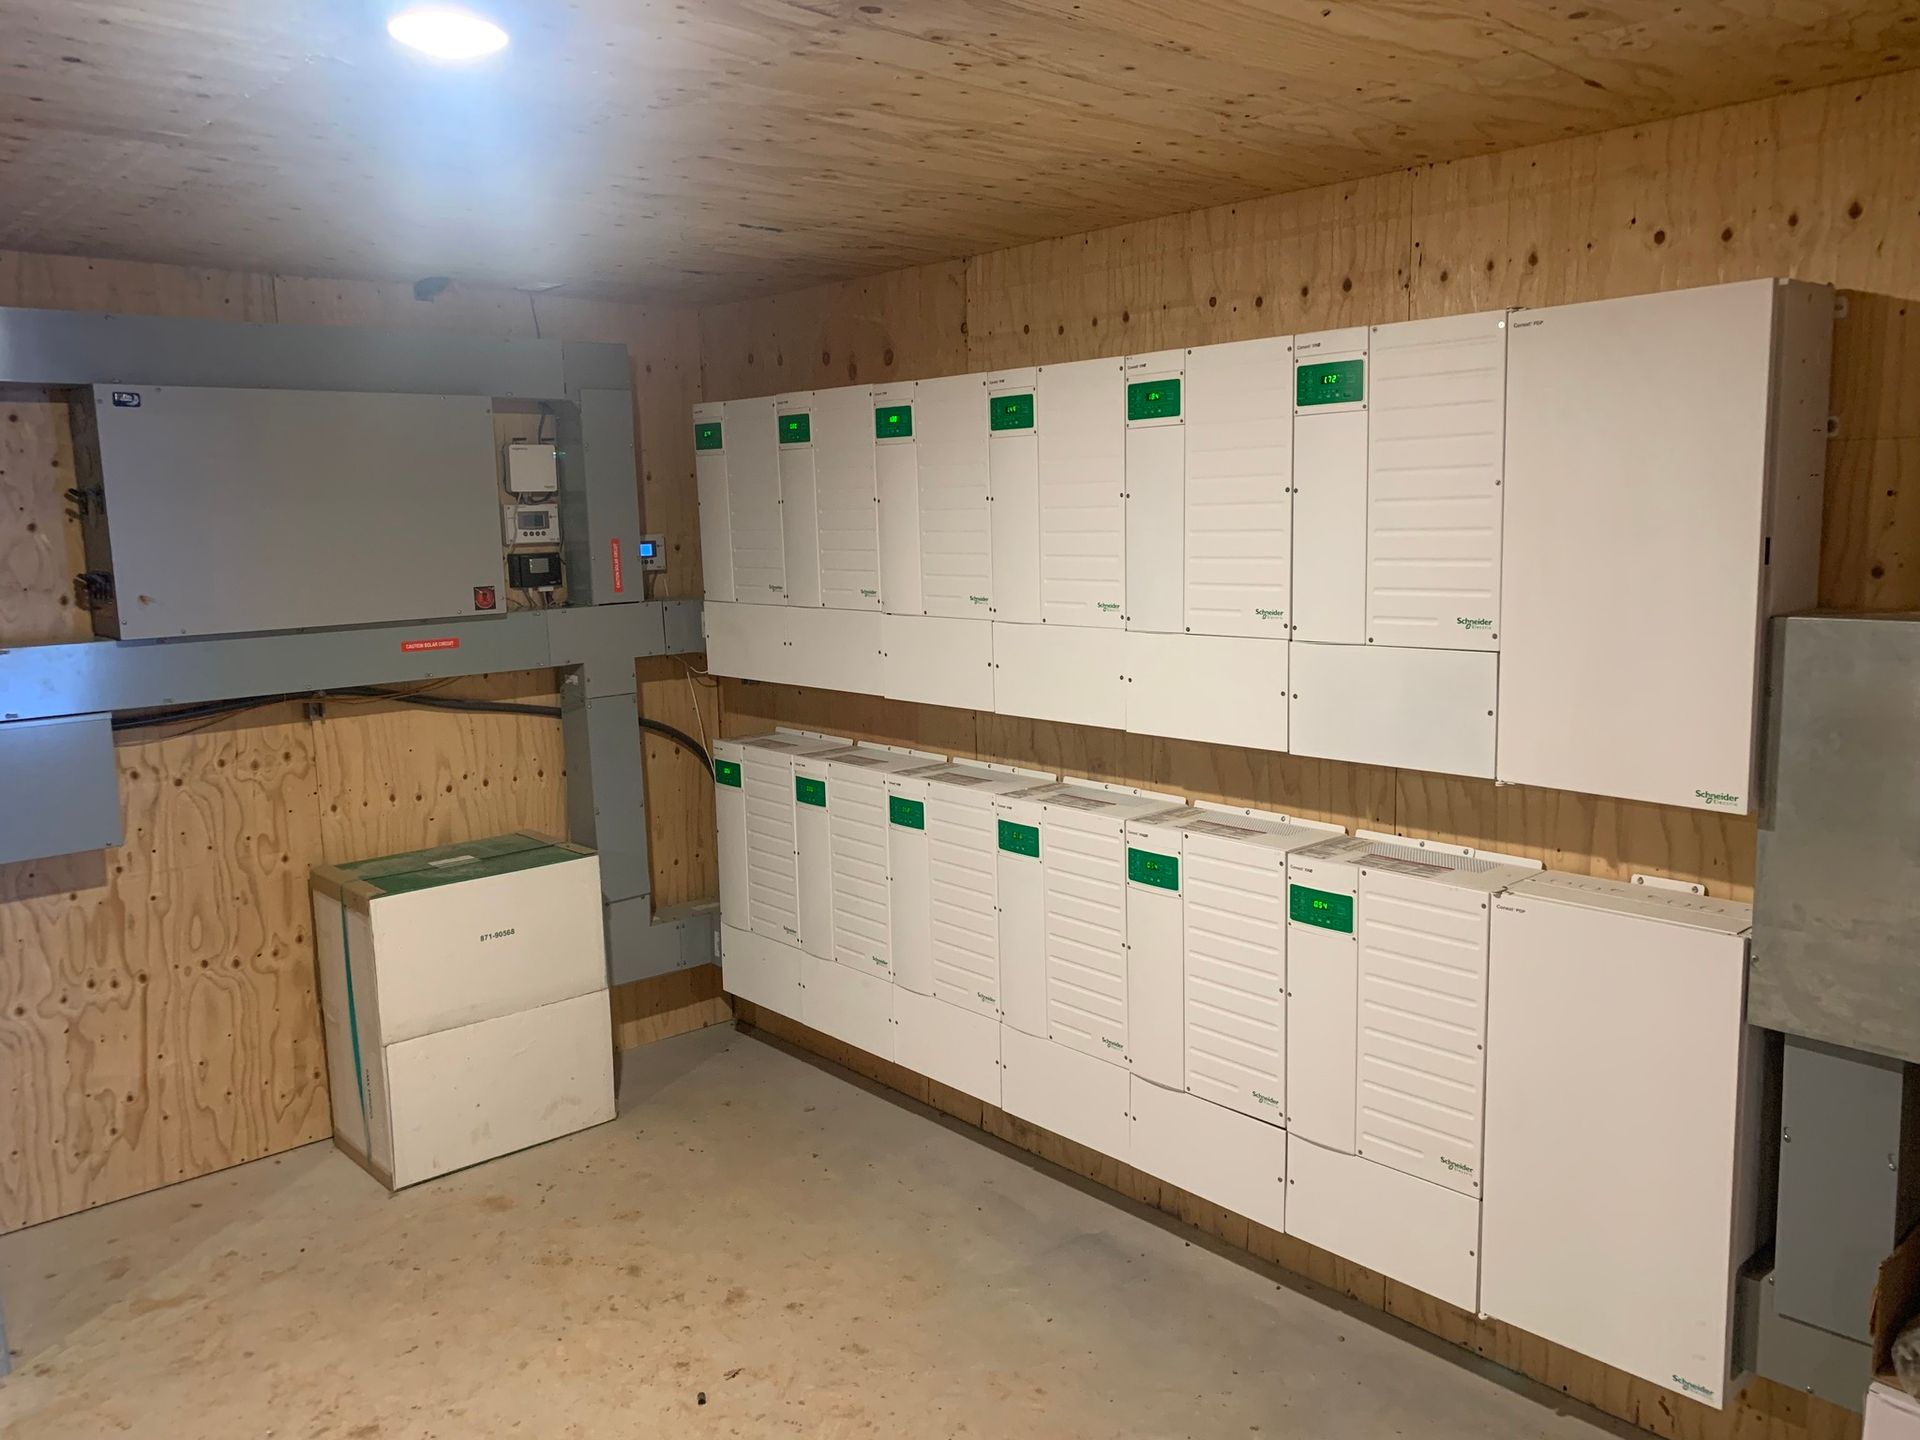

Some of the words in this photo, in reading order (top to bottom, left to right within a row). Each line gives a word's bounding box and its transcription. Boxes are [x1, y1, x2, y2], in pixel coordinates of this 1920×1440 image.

[1255, 608, 1284, 616] Schneider
[1456, 617, 1492, 626] Schneider
[1695, 790, 1739, 802] Schneider
[480, 928, 515, 942] 871-90568
[1252, 1091, 1279, 1104] Schneider
[1440, 1156, 1473, 1172] Schneider
[1671, 1375, 1714, 1395] Schneider
